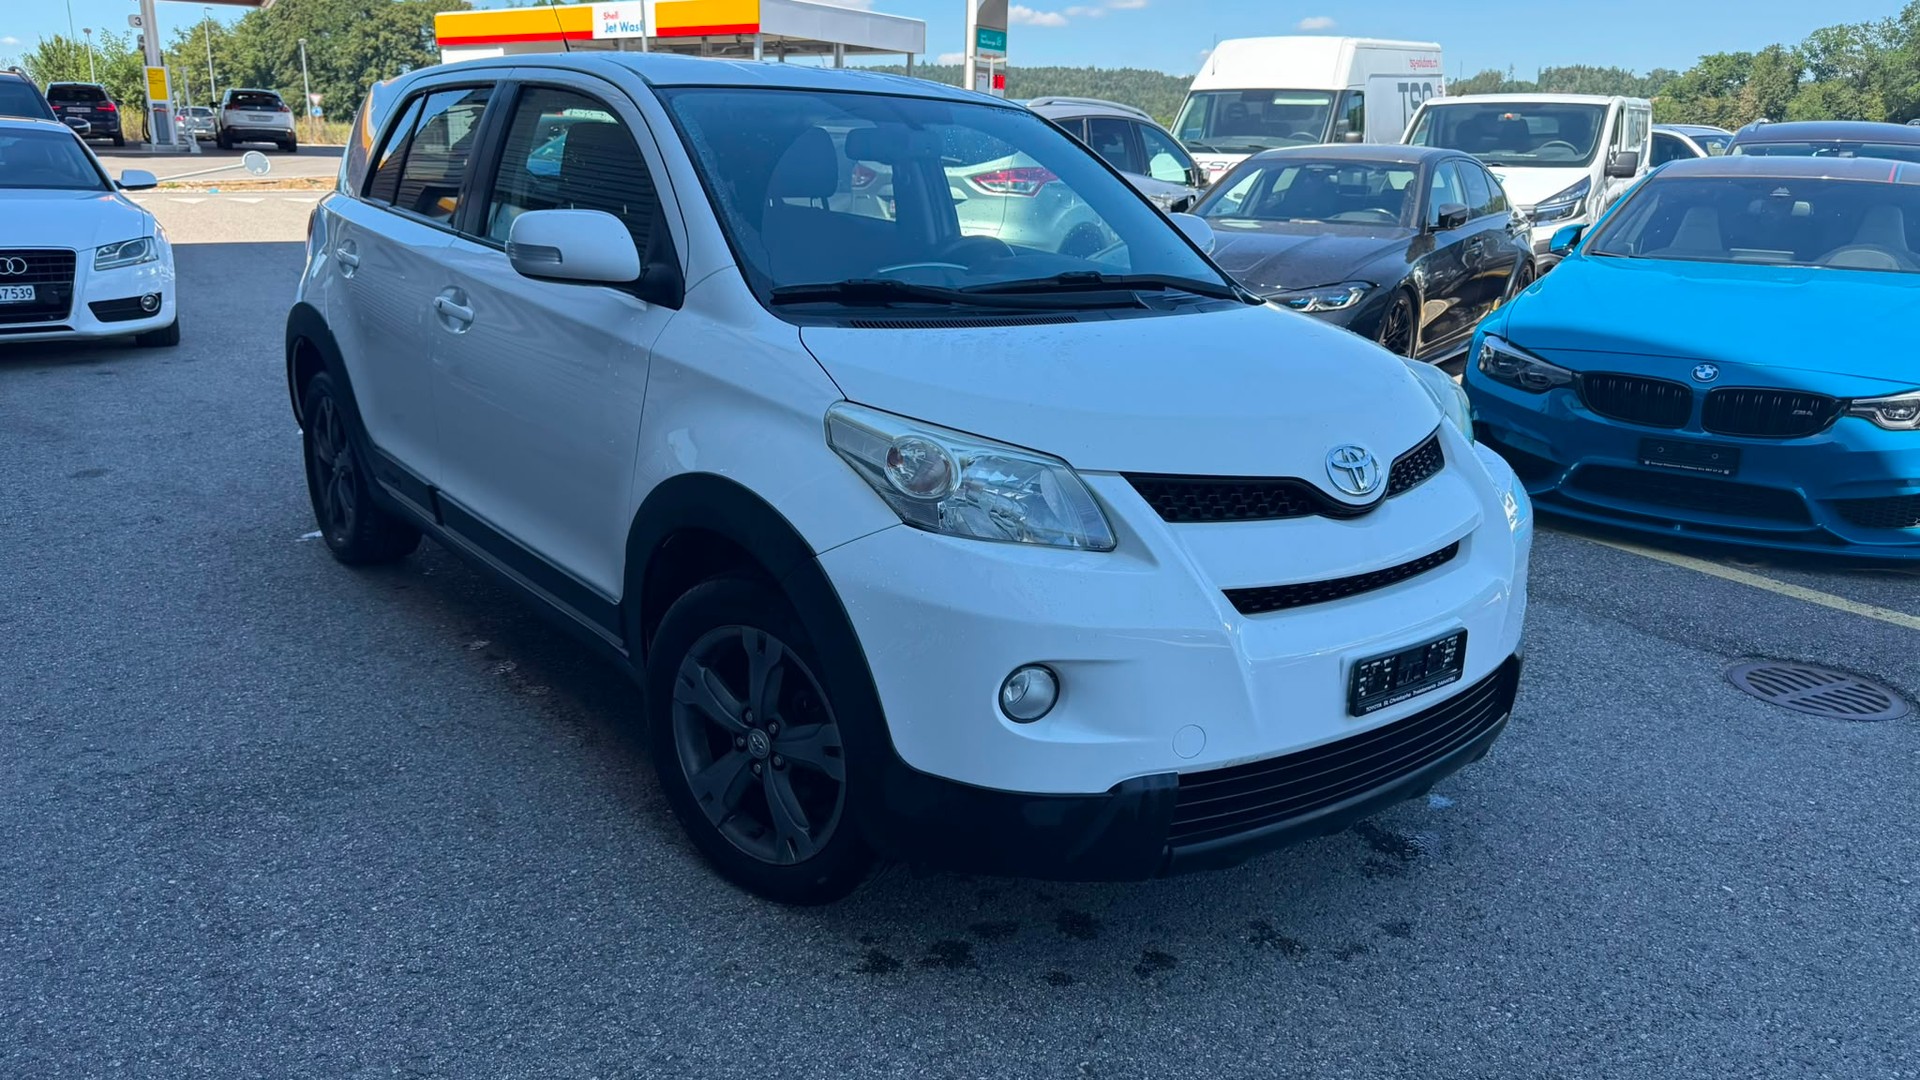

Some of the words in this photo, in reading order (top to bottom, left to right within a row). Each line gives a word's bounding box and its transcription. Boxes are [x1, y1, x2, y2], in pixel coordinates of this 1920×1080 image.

[603, 11, 619, 20] Shell
[134, 16, 142, 26] 3
[604, 22, 617, 33] Jet
[0, 288, 33, 299] 7539
